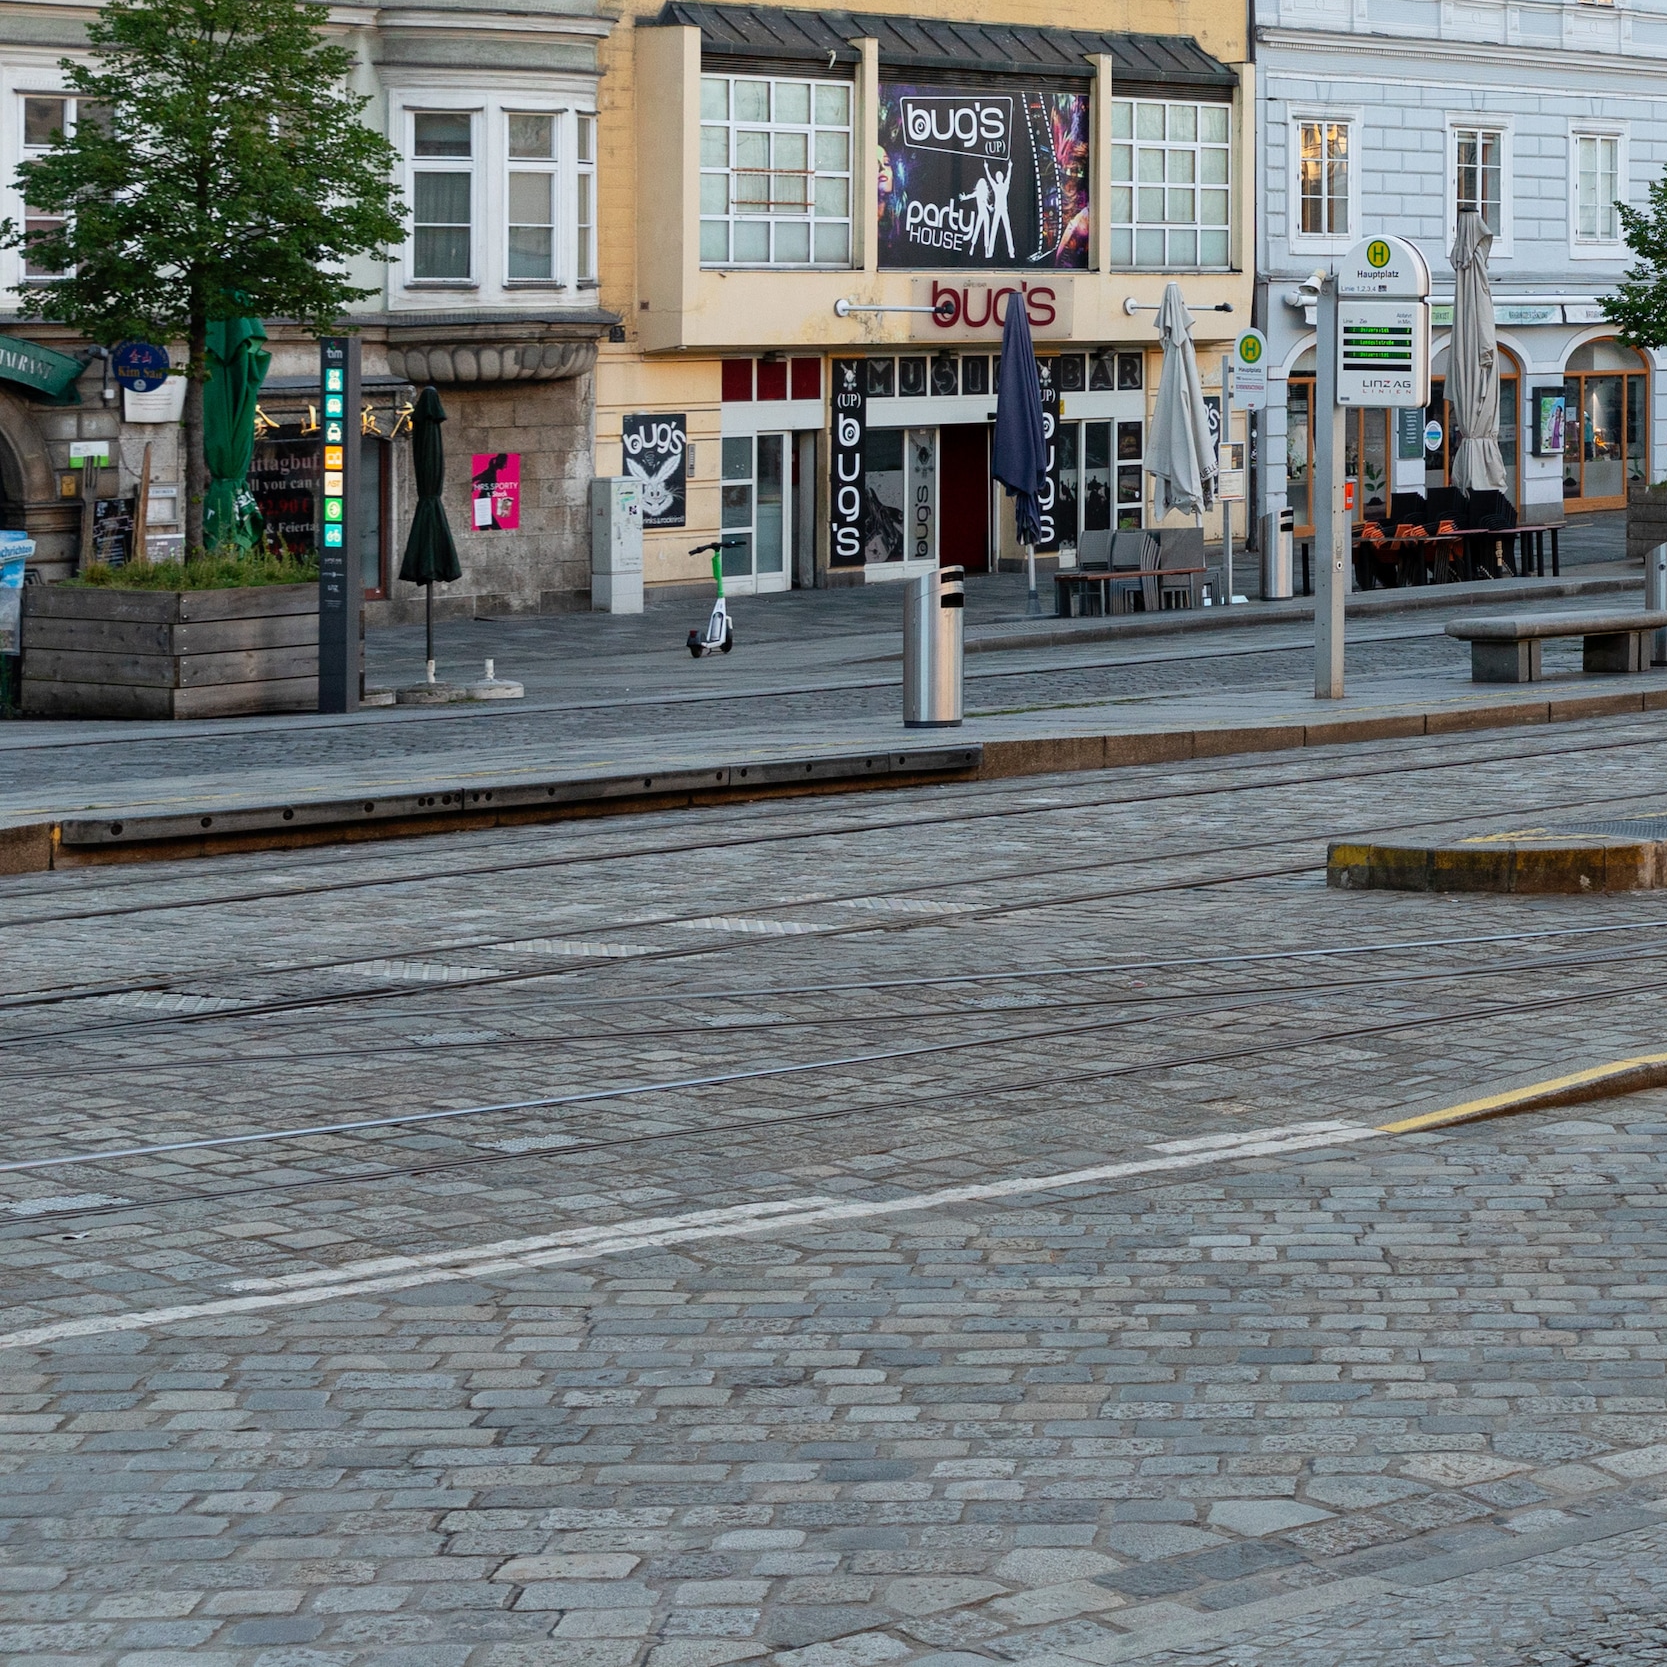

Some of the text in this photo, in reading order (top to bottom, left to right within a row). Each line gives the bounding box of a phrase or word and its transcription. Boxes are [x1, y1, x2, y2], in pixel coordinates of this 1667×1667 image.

[907, 102, 1005, 147] bug's
[985, 139, 1006, 154] (UP)
[906, 198, 976, 241] party
[909, 225, 964, 251] HOUSE
[1357, 269, 1399, 279] Hauptplatz
[118, 365, 139, 377] Kim
[867, 355, 1140, 397] MUSI BAR
[1393, 380, 1411, 388] AG
[837, 393, 861, 408] (UP)
[622, 421, 687, 454] bug's
[263, 481, 286, 494] you
[290, 479, 313, 489] can
[914, 485, 932, 557] bug's
